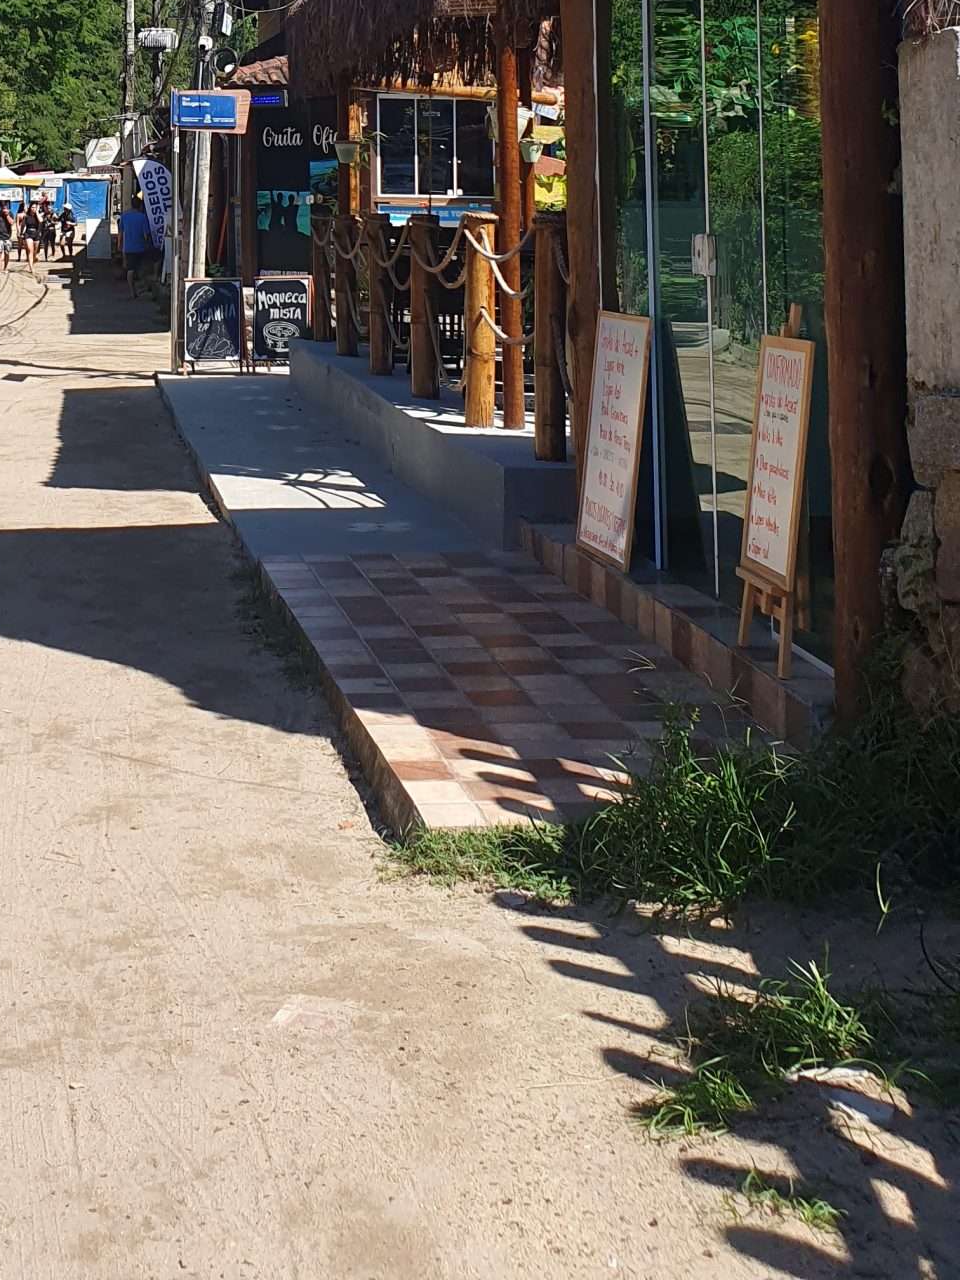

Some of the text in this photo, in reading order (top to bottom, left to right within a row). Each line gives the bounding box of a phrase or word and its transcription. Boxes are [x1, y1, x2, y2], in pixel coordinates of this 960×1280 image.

[262, 126, 303, 147] Gruta
[155, 166, 172, 212] TICOS
[257, 291, 307, 311] Moqueca
